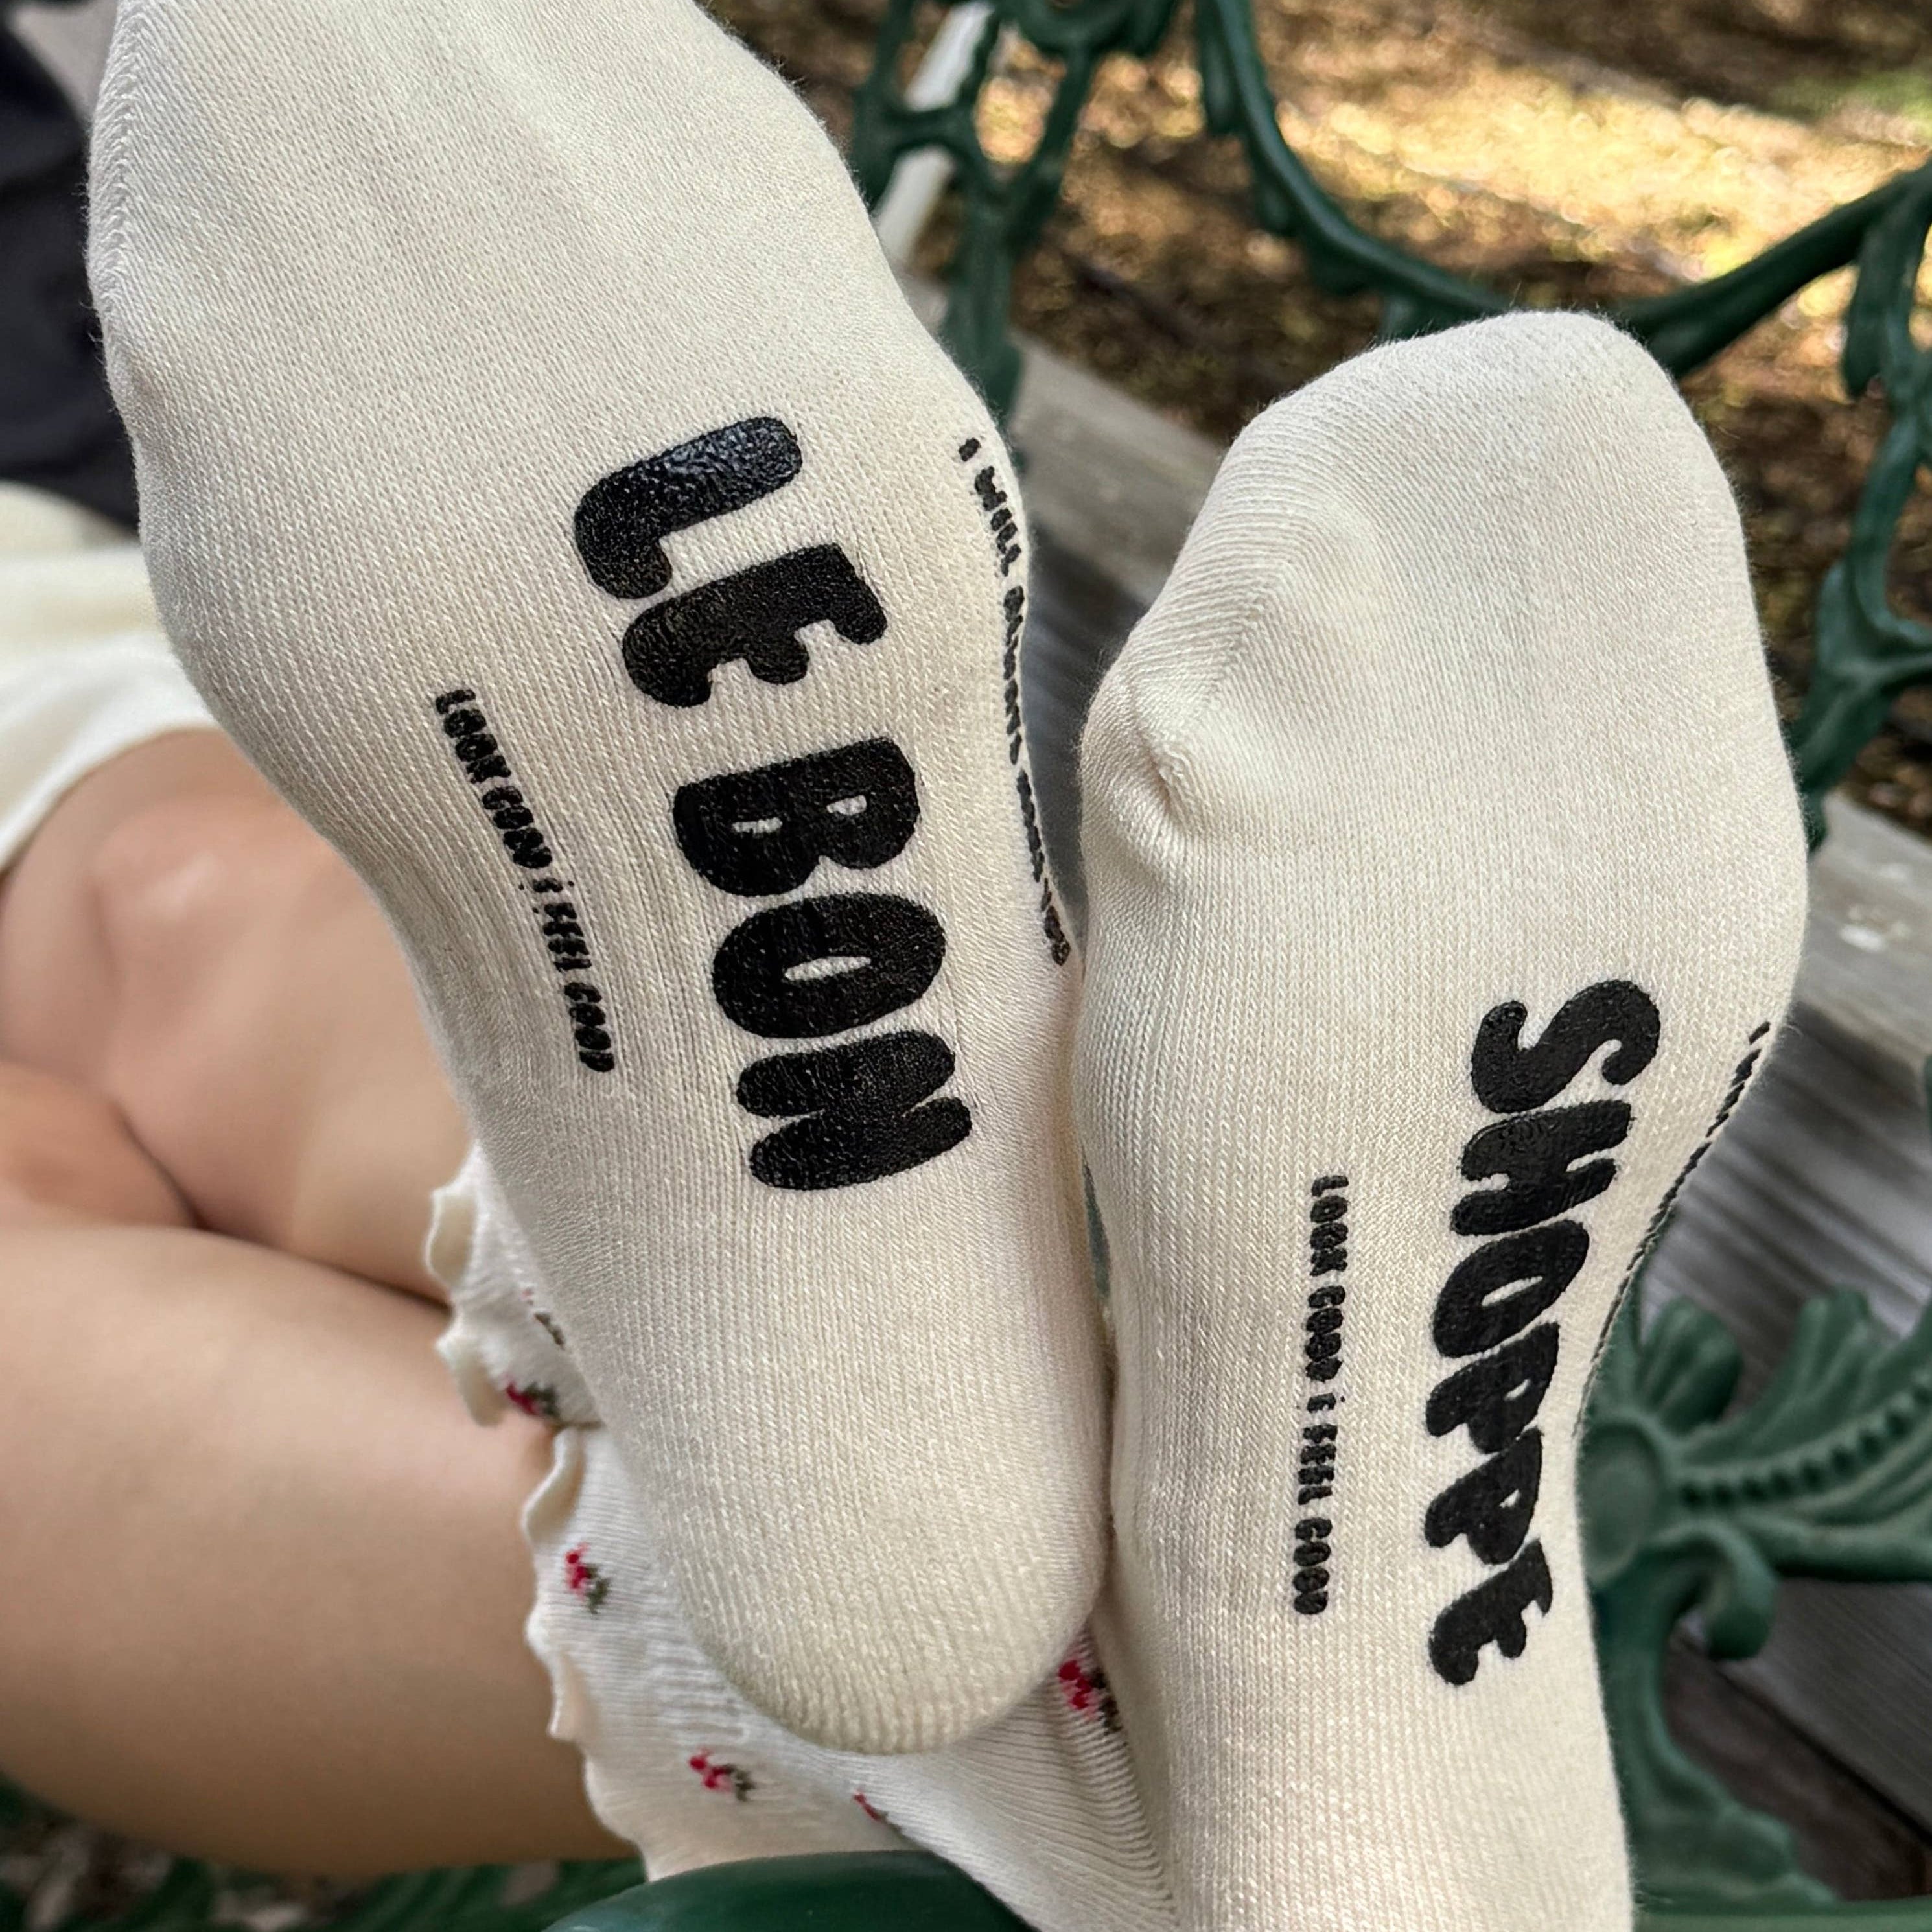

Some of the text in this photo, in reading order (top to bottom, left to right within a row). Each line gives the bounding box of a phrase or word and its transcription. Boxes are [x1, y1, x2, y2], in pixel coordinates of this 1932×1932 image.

[573, 416, 973, 1192] LE BON
[435, 688, 513, 786] LOOK
[562, 980, 616, 1074] GOOD
[1309, 1175, 1349, 1277] LOOK
[1303, 1285, 1346, 1384] GOOD
[1424, 979, 1662, 1687] SHOPPE
[1297, 1423, 1338, 1506] FEEL
[1292, 1517, 1333, 1616] GOOD
